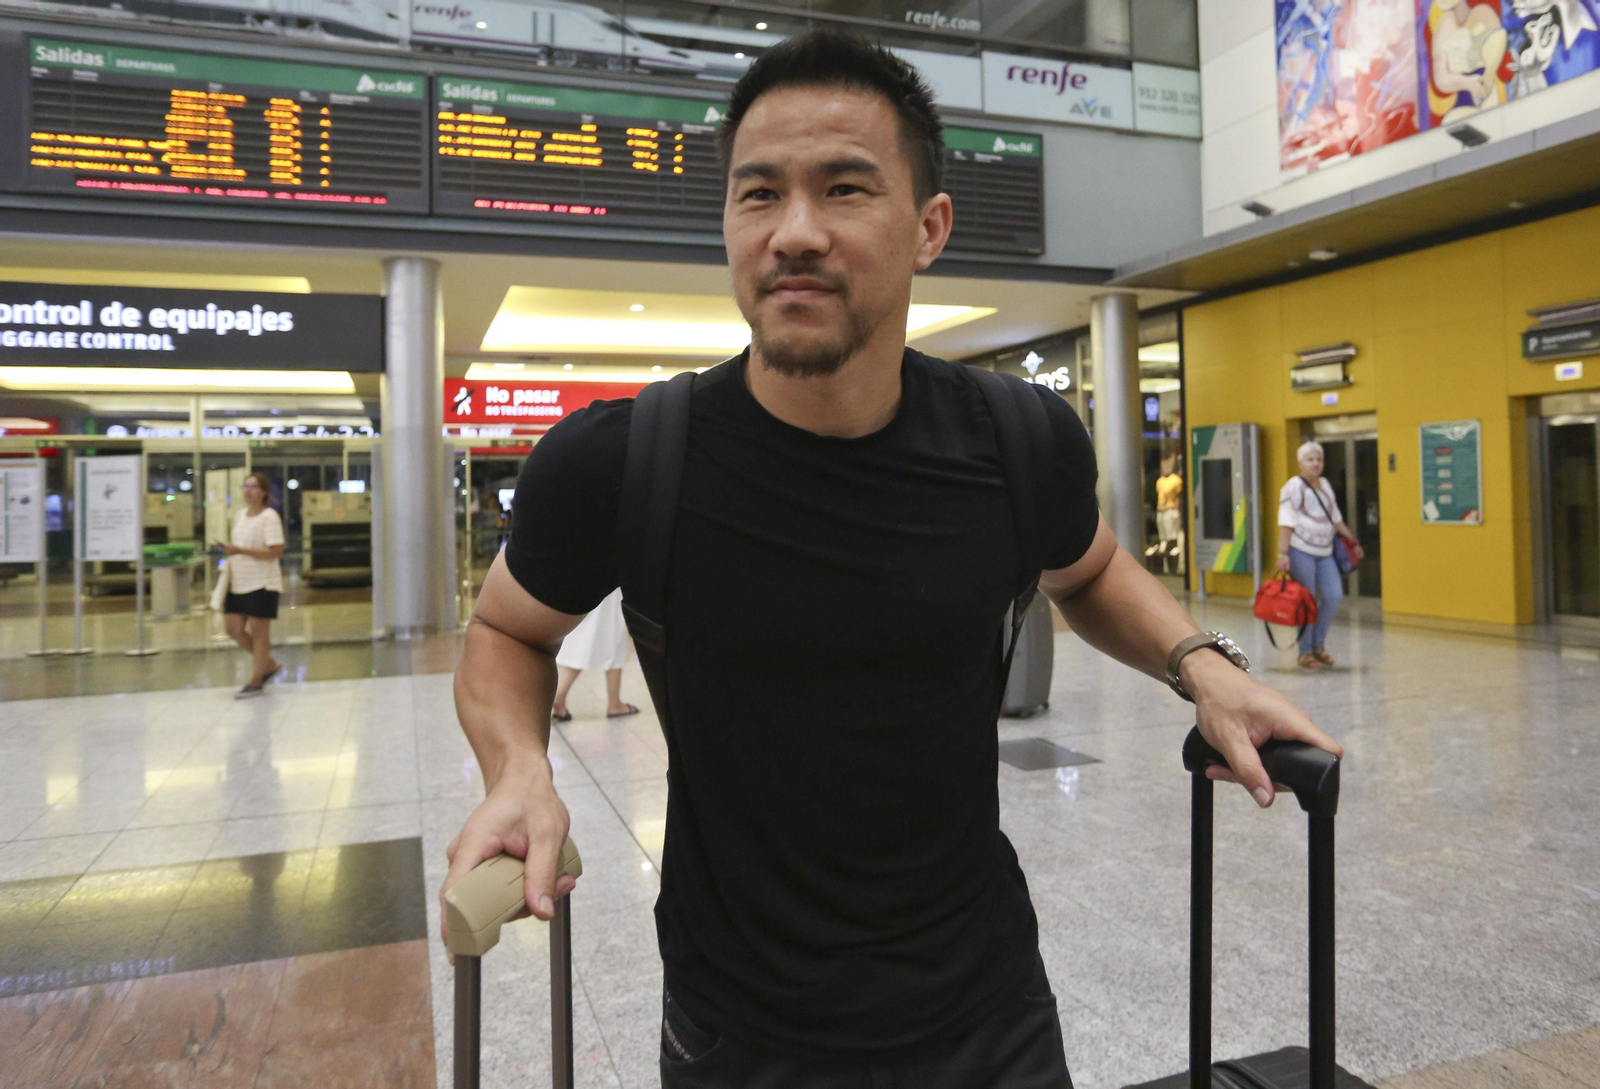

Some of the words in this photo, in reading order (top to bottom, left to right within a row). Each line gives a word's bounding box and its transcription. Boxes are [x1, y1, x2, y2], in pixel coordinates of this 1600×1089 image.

[414, 5, 472, 20] renfe
[905, 10, 982, 31] renfe.com
[35, 45, 105, 67] Salidas
[1007, 61, 1087, 95] renfe
[442, 82, 498, 101] Salidas
[99, 301, 143, 328] de
[148, 303, 294, 336] equipajes
[0, 330, 80, 349] GGAGE
[80, 331, 176, 351] CONTROL
[486, 386, 510, 404] No
[512, 389, 560, 406] pasar
